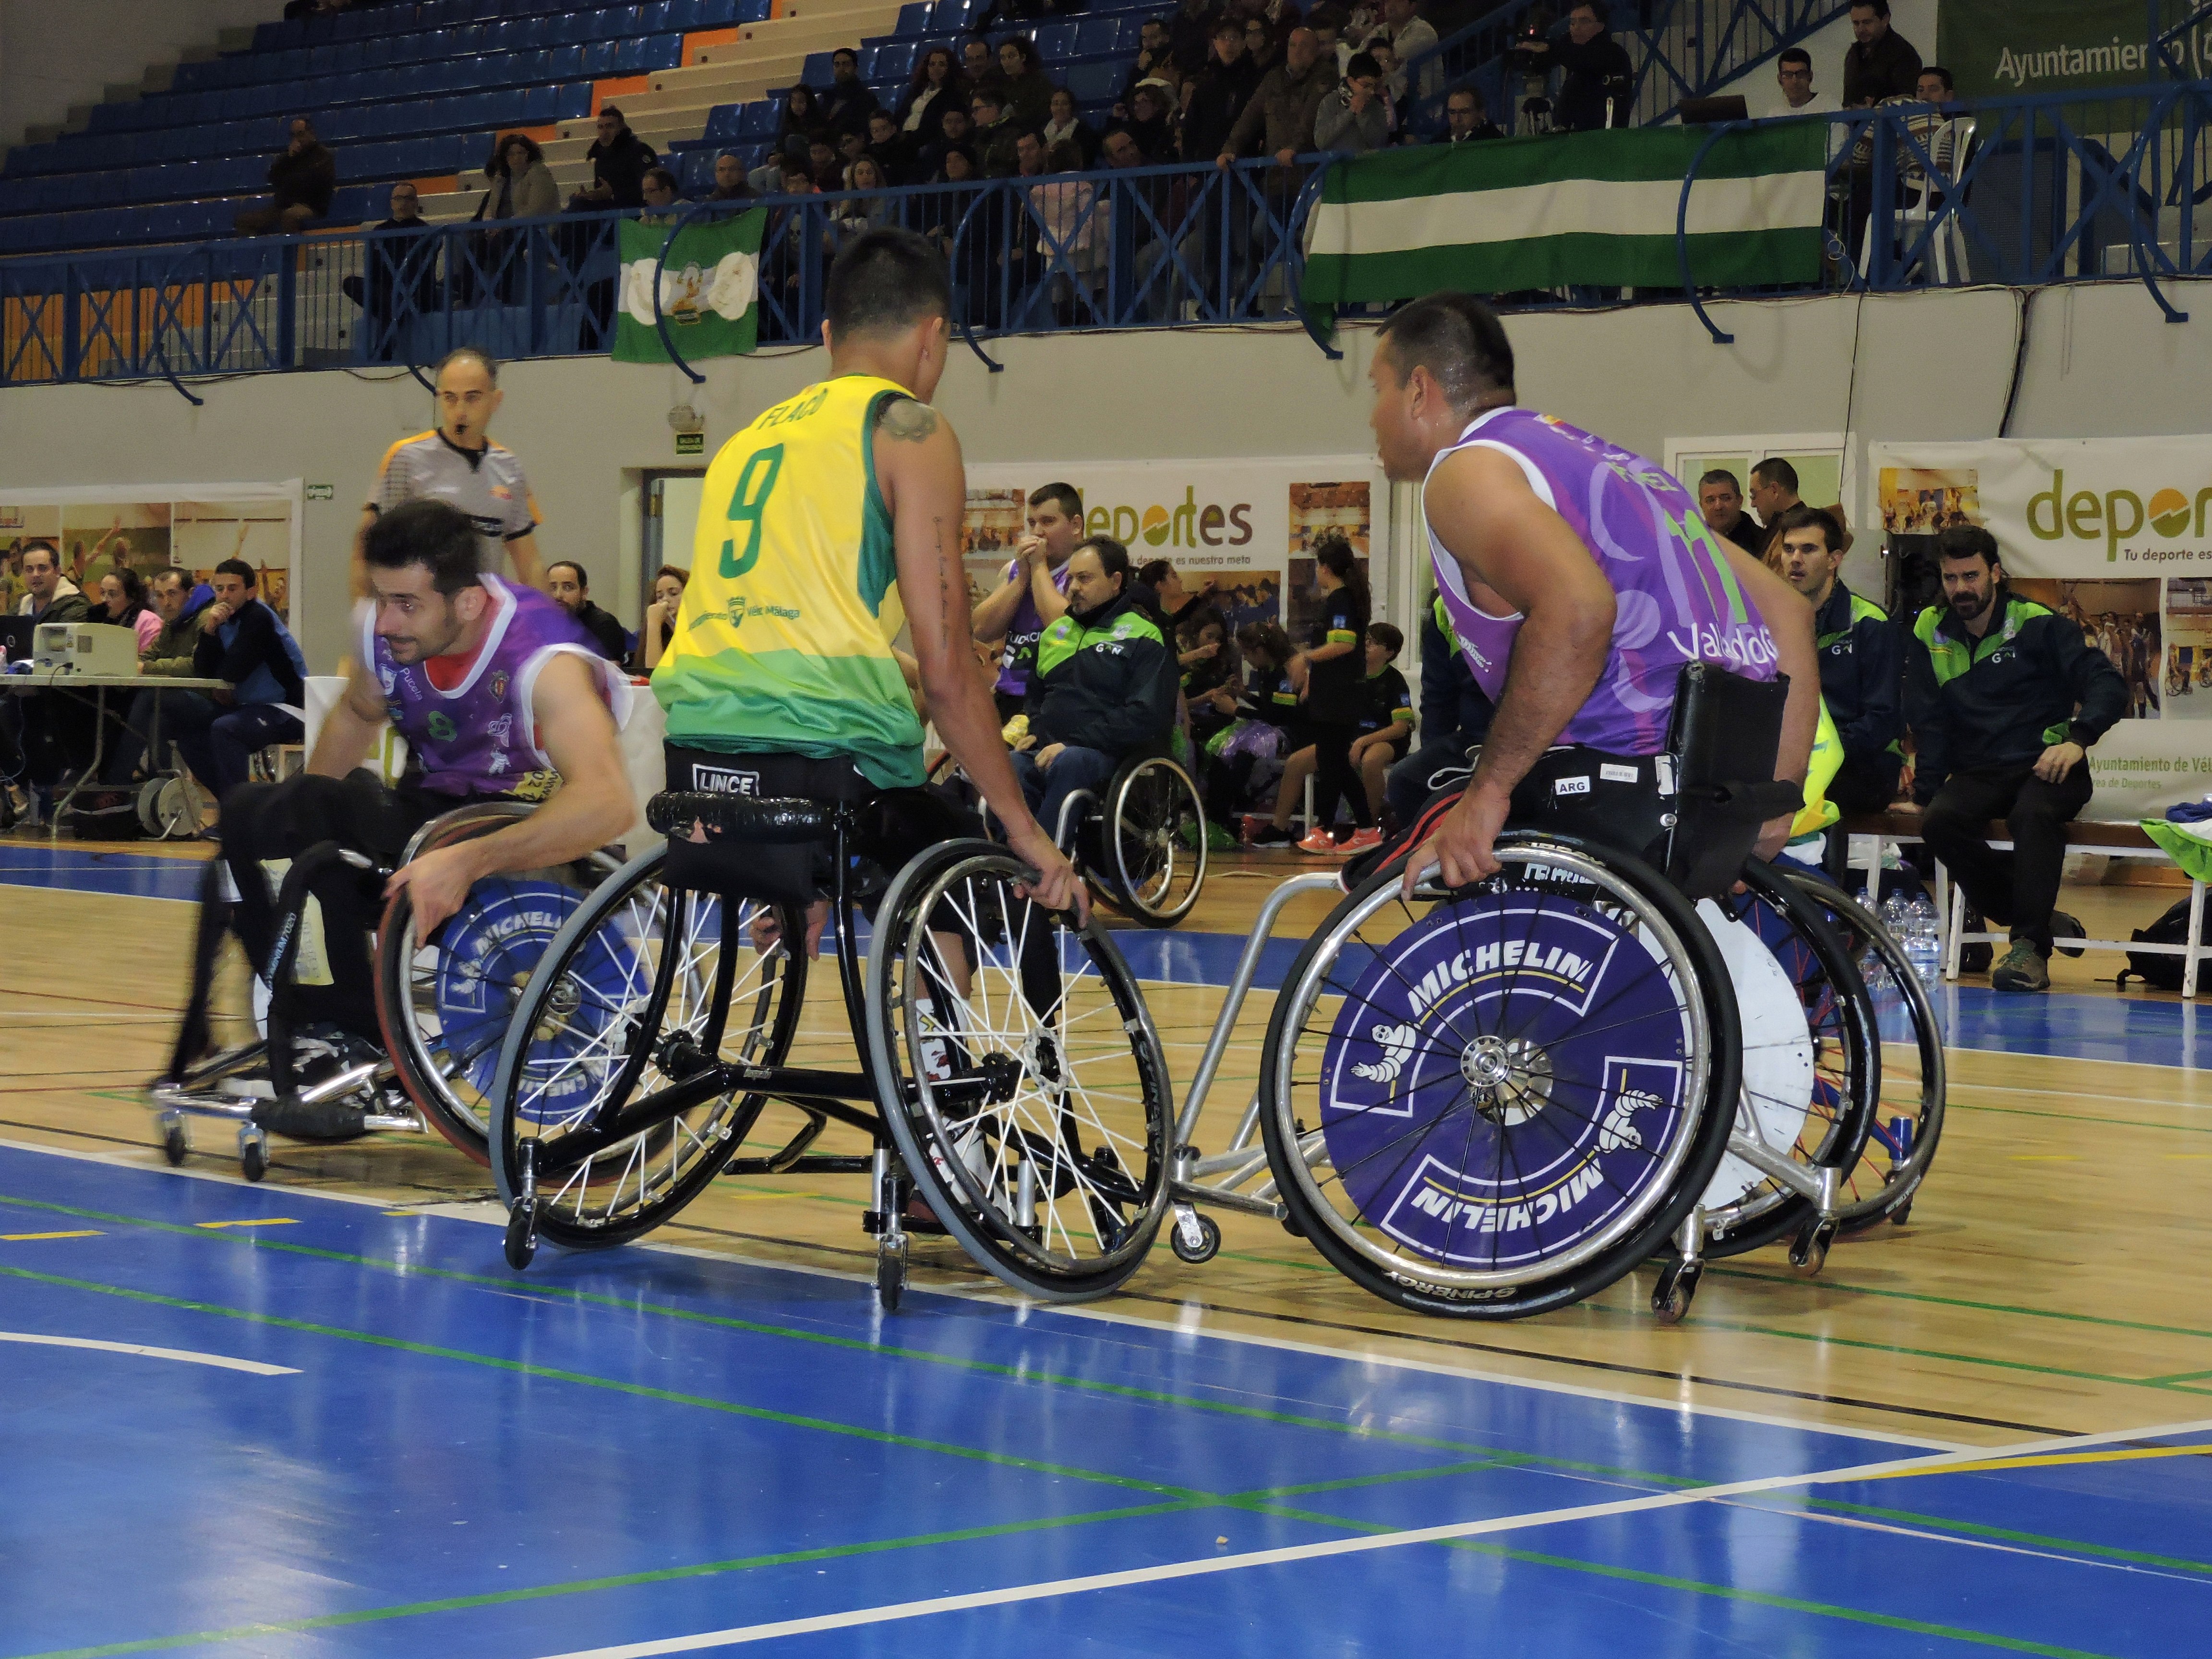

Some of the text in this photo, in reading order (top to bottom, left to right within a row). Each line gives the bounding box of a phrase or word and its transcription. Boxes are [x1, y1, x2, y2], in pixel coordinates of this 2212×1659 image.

[1995, 36, 2184, 88] Ayuntamieno
[718, 443, 784, 579] 9
[1076, 485, 1253, 548] eportes
[1176, 557, 1187, 565] es
[1189, 556, 1224, 565] nuestra
[1227, 554, 1251, 565] meta
[2124, 548, 2212, 564] Tu deporte es
[401, 667, 423, 701] Pucela
[428, 710, 457, 742] 8
[2089, 756, 2170, 773] Ayuntamiento
[2174, 756, 2188, 772] de
[699, 772, 754, 795] LINCE
[1560, 782, 1585, 793] ARG
[2093, 778, 2162, 789] rea de Deportes
[1407, 939, 1594, 1017] MICHELIN
[1410, 1157, 1604, 1233] MICHELIN
